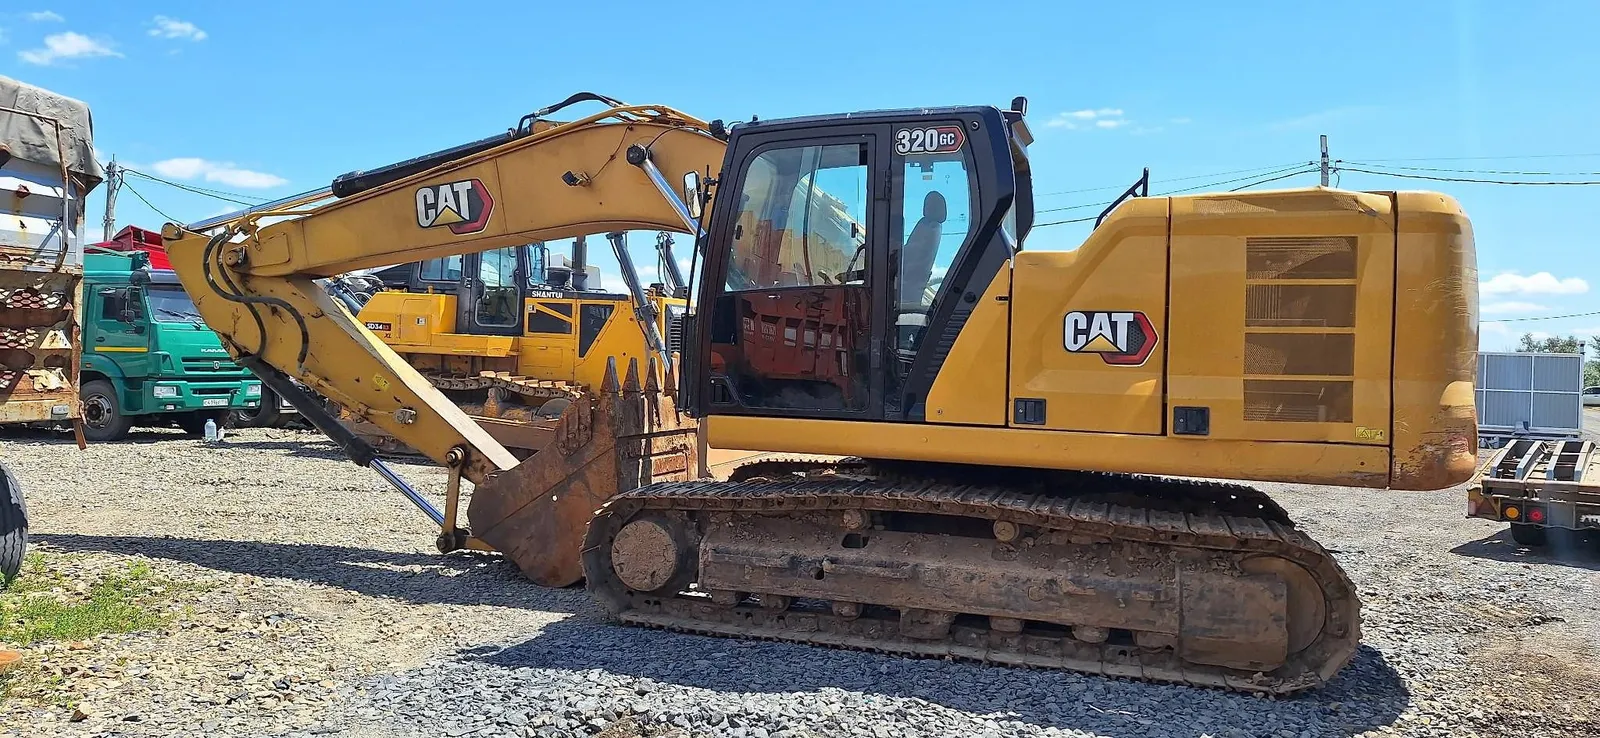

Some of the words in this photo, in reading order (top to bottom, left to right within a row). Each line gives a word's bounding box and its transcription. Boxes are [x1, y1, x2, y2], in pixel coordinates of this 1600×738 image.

[898, 129, 938, 153] 320
[940, 133, 955, 145] GC
[416, 180, 472, 228] CAT
[531, 290, 563, 299] SHANTUI
[1065, 311, 1134, 352] CAT
